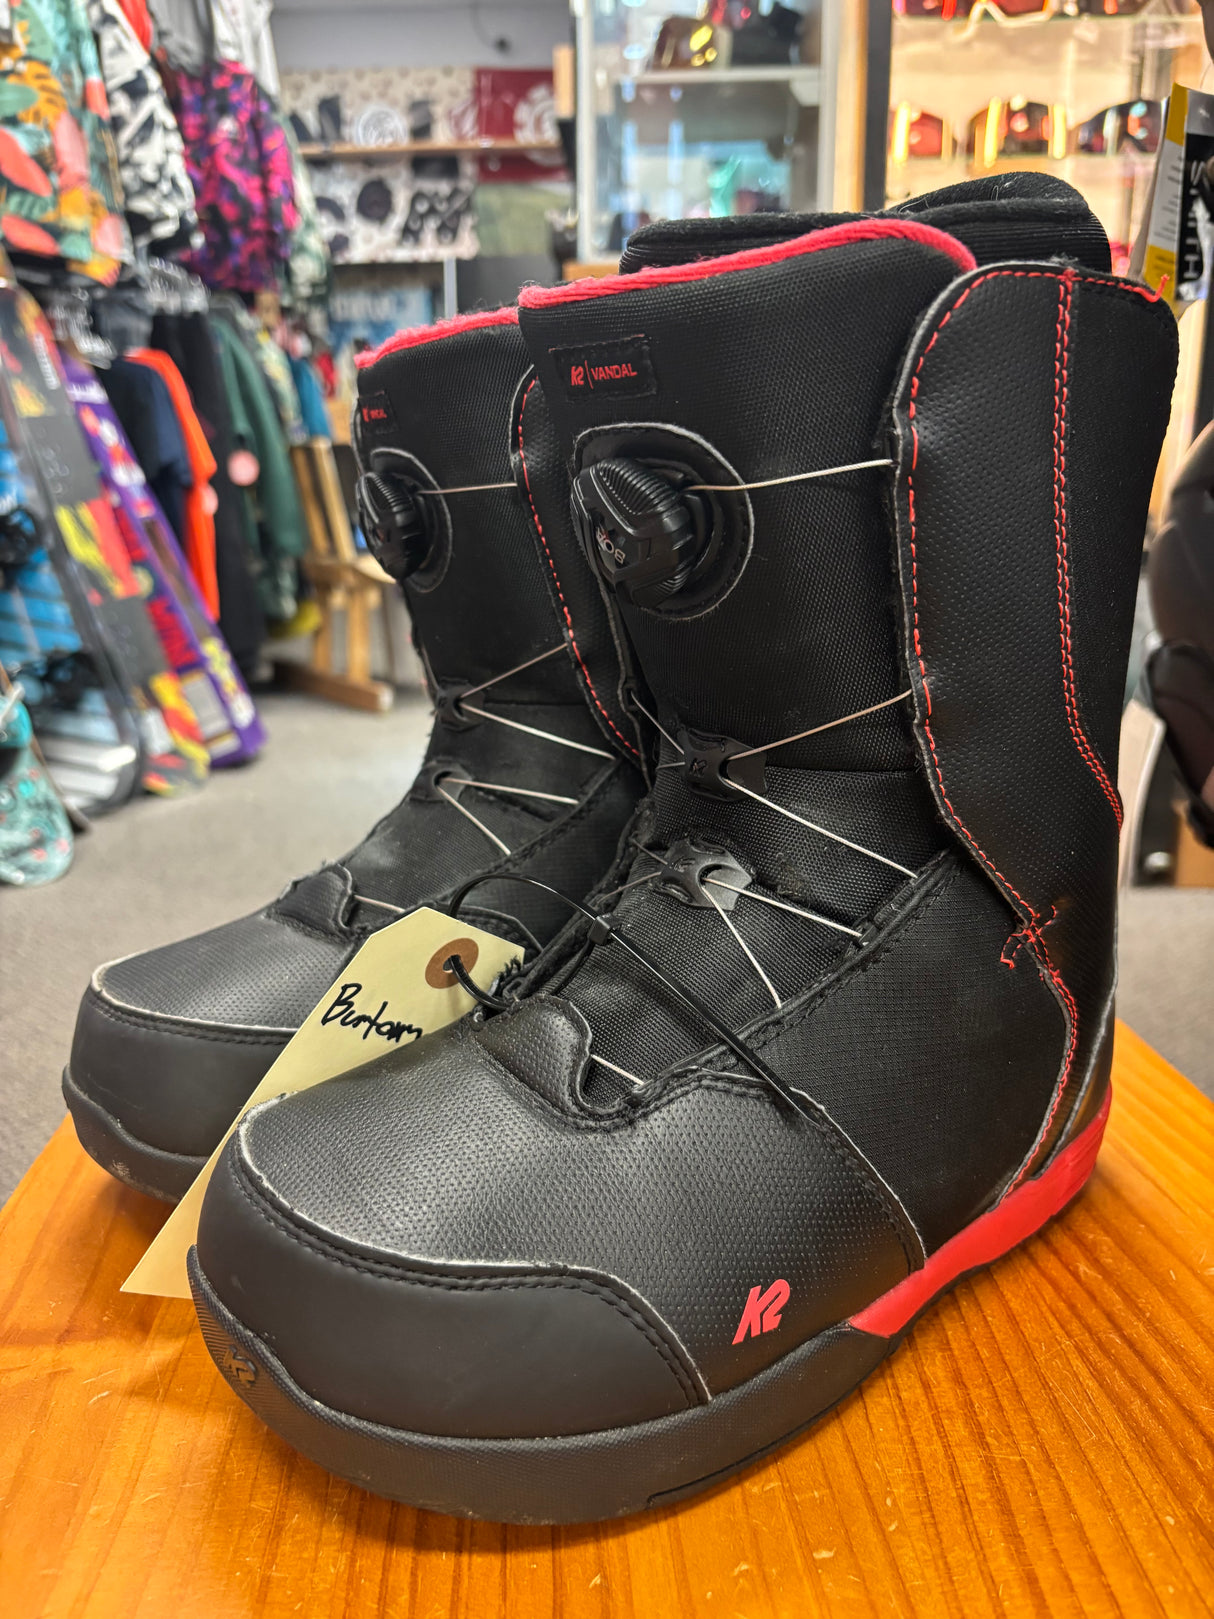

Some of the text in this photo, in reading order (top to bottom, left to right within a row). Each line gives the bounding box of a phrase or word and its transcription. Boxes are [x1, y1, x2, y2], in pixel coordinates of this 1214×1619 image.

[571, 363, 638, 386] K2 VANDAL
[732, 1279, 791, 1346] K2
